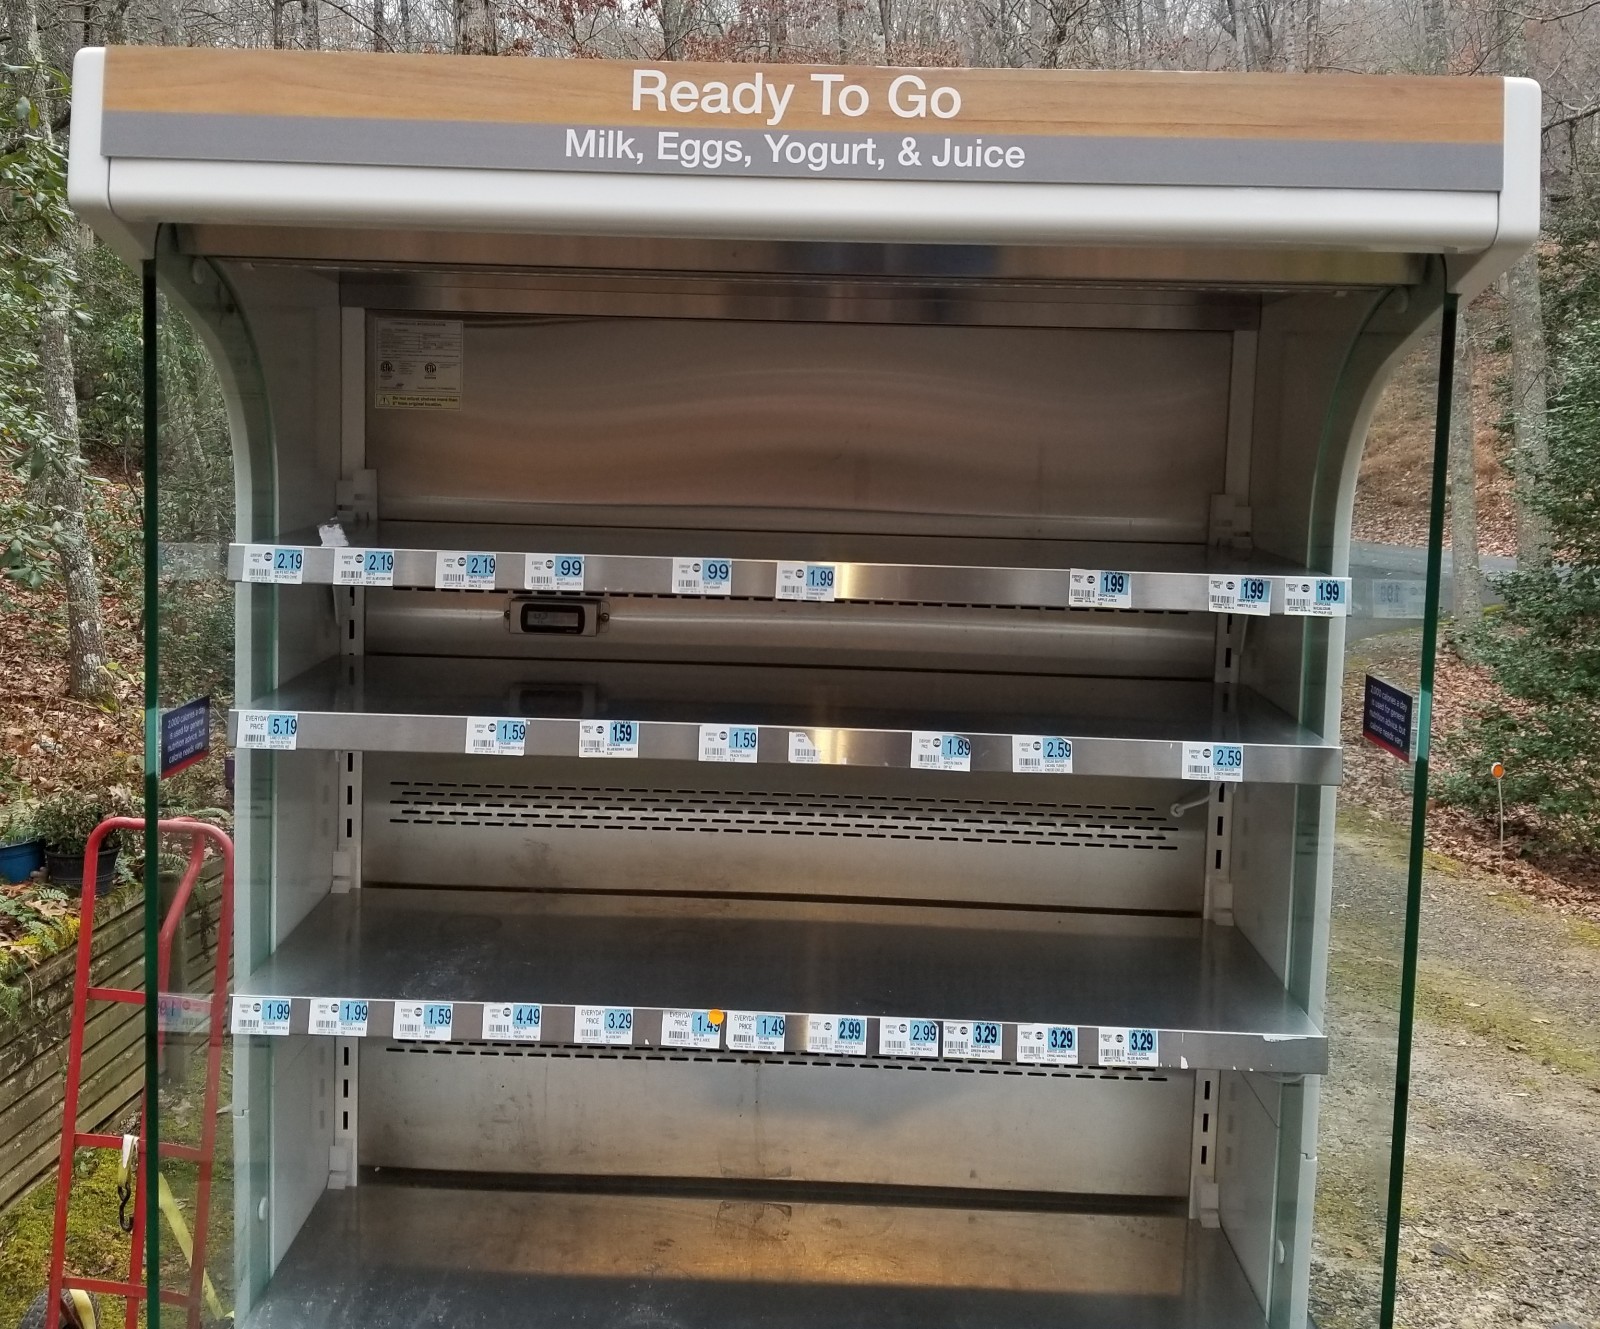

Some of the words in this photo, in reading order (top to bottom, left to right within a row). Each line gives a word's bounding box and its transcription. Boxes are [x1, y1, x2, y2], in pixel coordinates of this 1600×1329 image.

[632, 69, 795, 125] Ready
[811, 73, 869, 117] To
[888, 75, 961, 119] Go
[565, 128, 643, 164] Milk,
[657, 132, 752, 168] Eggs,
[764, 134, 885, 170] Yogurt,
[897, 137, 922, 167] &
[932, 138, 1026, 168] Juice
[1375, 700, 1385, 711] used
[1390, 709, 1405, 723] general
[1382, 692, 1397, 706] calories
[1399, 700, 1408, 713] day
[180, 710, 195, 723] calories
[173, 726, 184, 738] used
[190, 717, 204, 732] general
[1398, 723, 1406, 736] but
